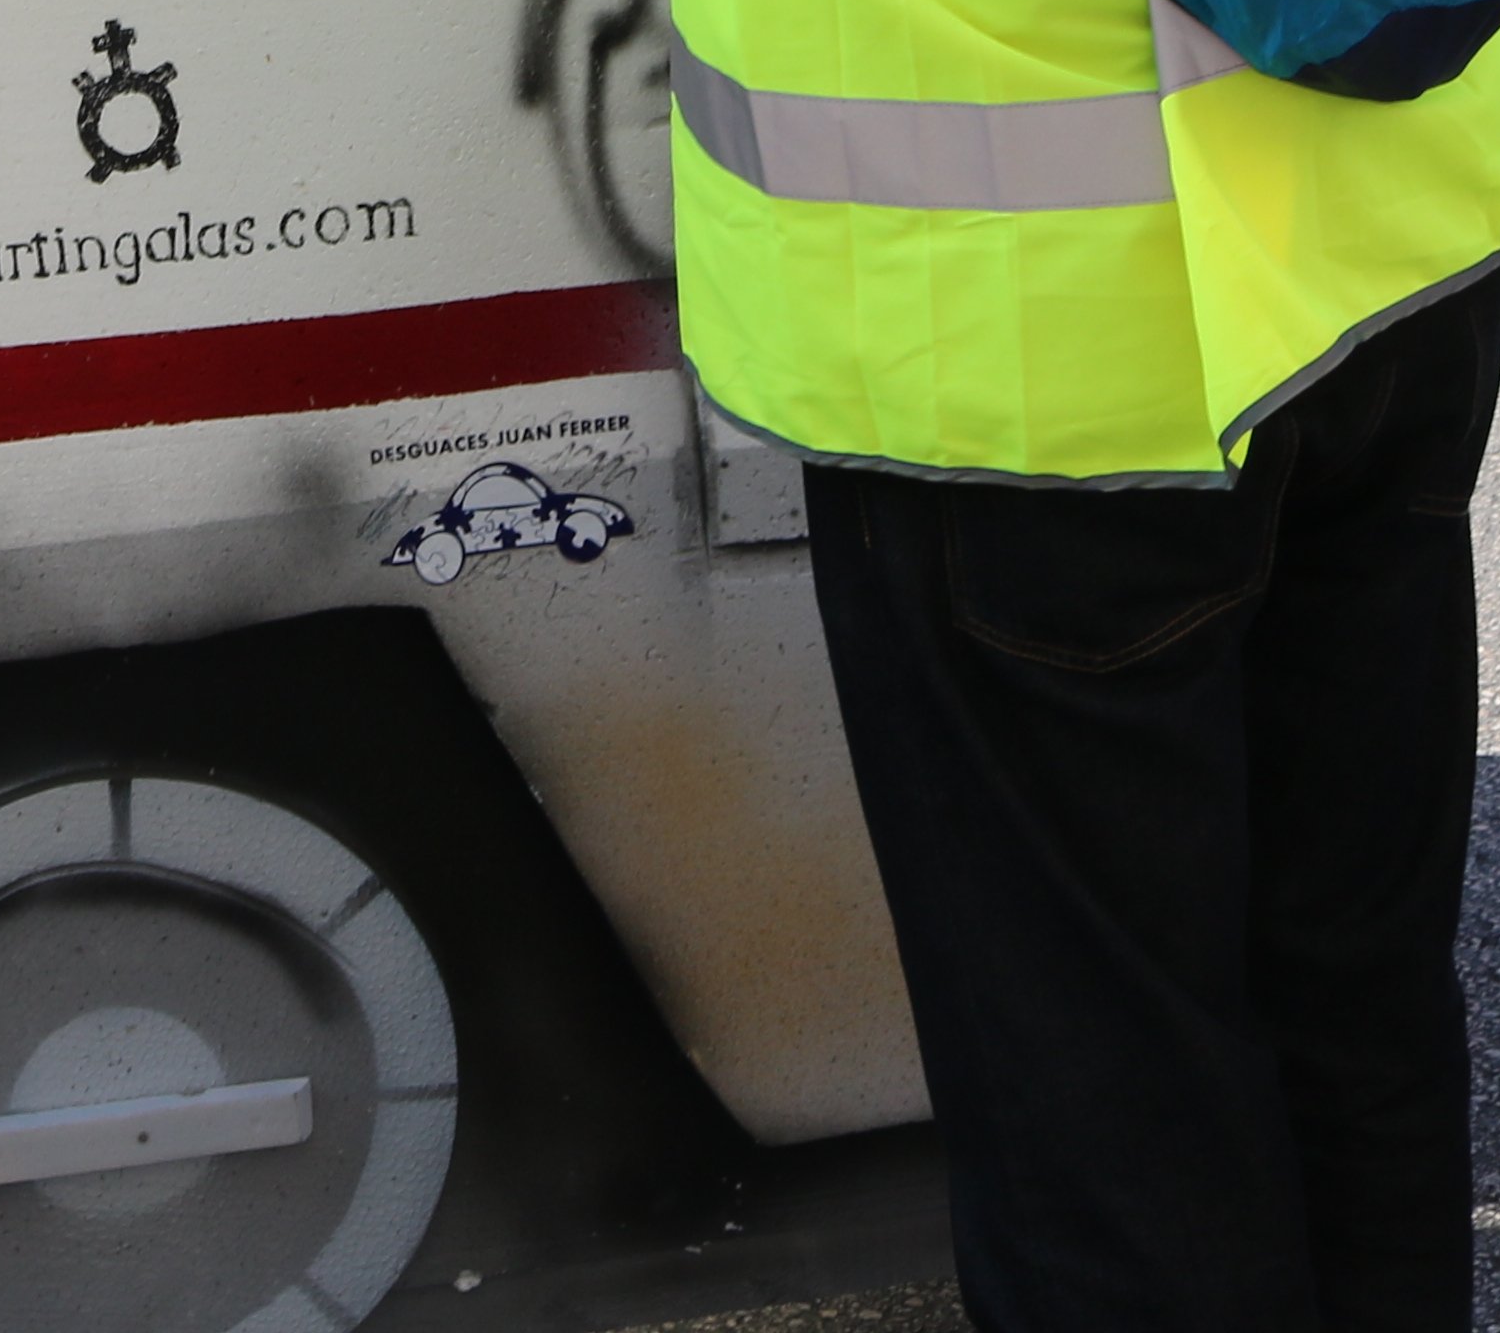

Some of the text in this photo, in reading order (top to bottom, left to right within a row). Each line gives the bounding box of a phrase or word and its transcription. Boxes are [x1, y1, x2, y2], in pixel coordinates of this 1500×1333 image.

[370, 414, 632, 466] DESGUACES JUAN FERRER
